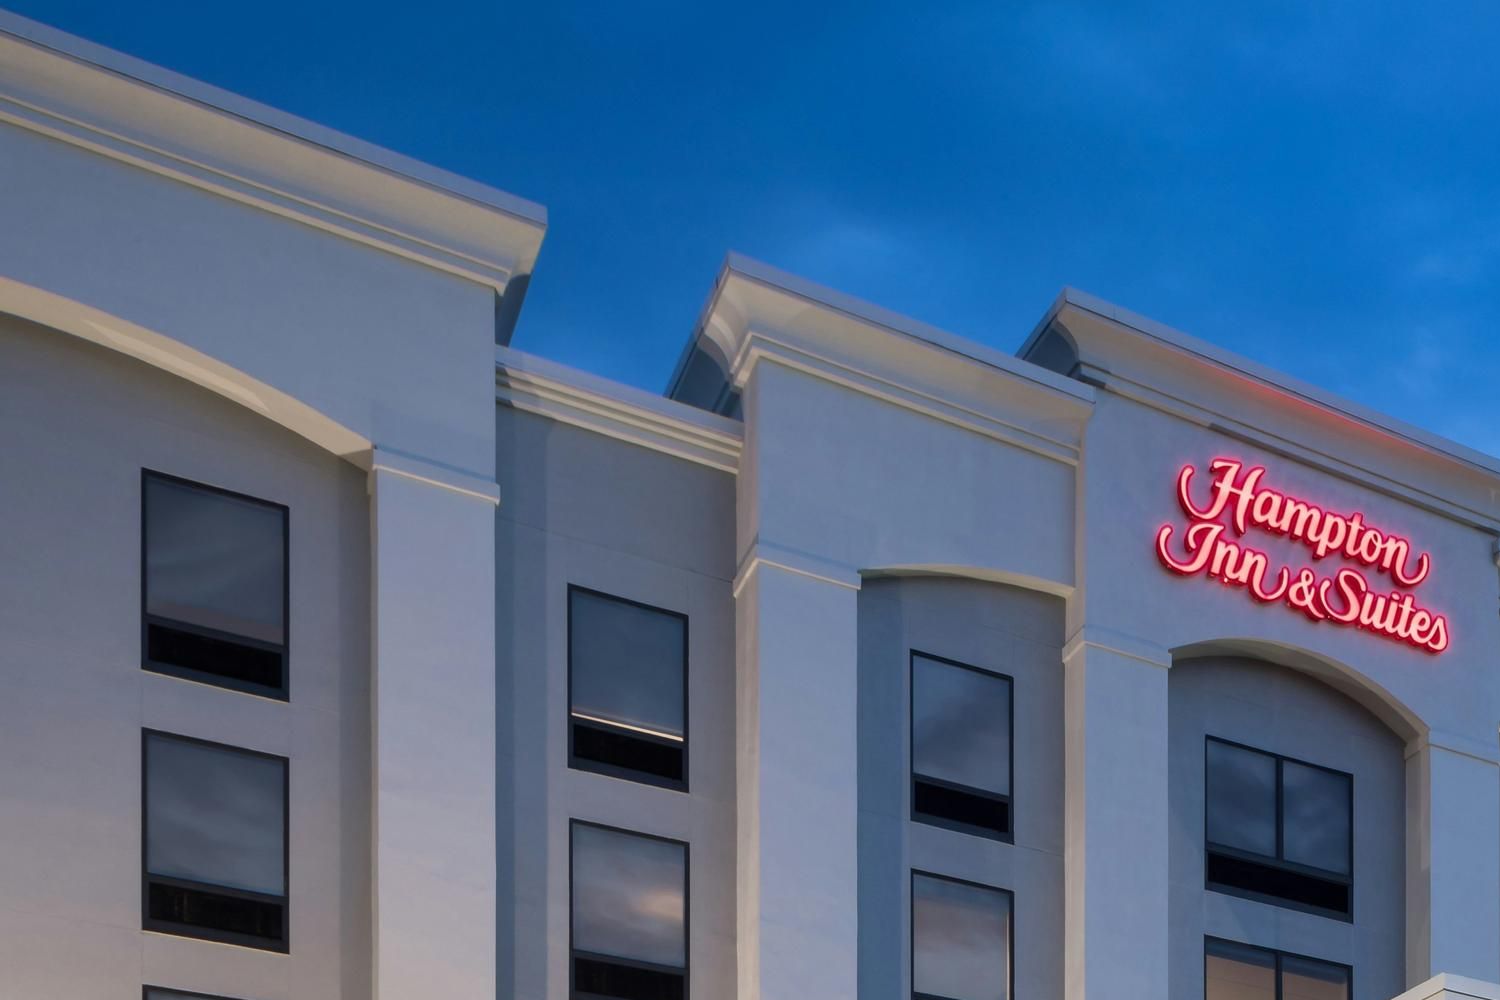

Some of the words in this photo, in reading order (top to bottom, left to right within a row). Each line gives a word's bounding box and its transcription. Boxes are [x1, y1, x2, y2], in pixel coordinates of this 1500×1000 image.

[1156, 522, 1290, 602] Inn
[1288, 568, 1325, 620] &
[1319, 569, 1449, 654] Suites
[1177, 458, 1430, 588] Hampton
